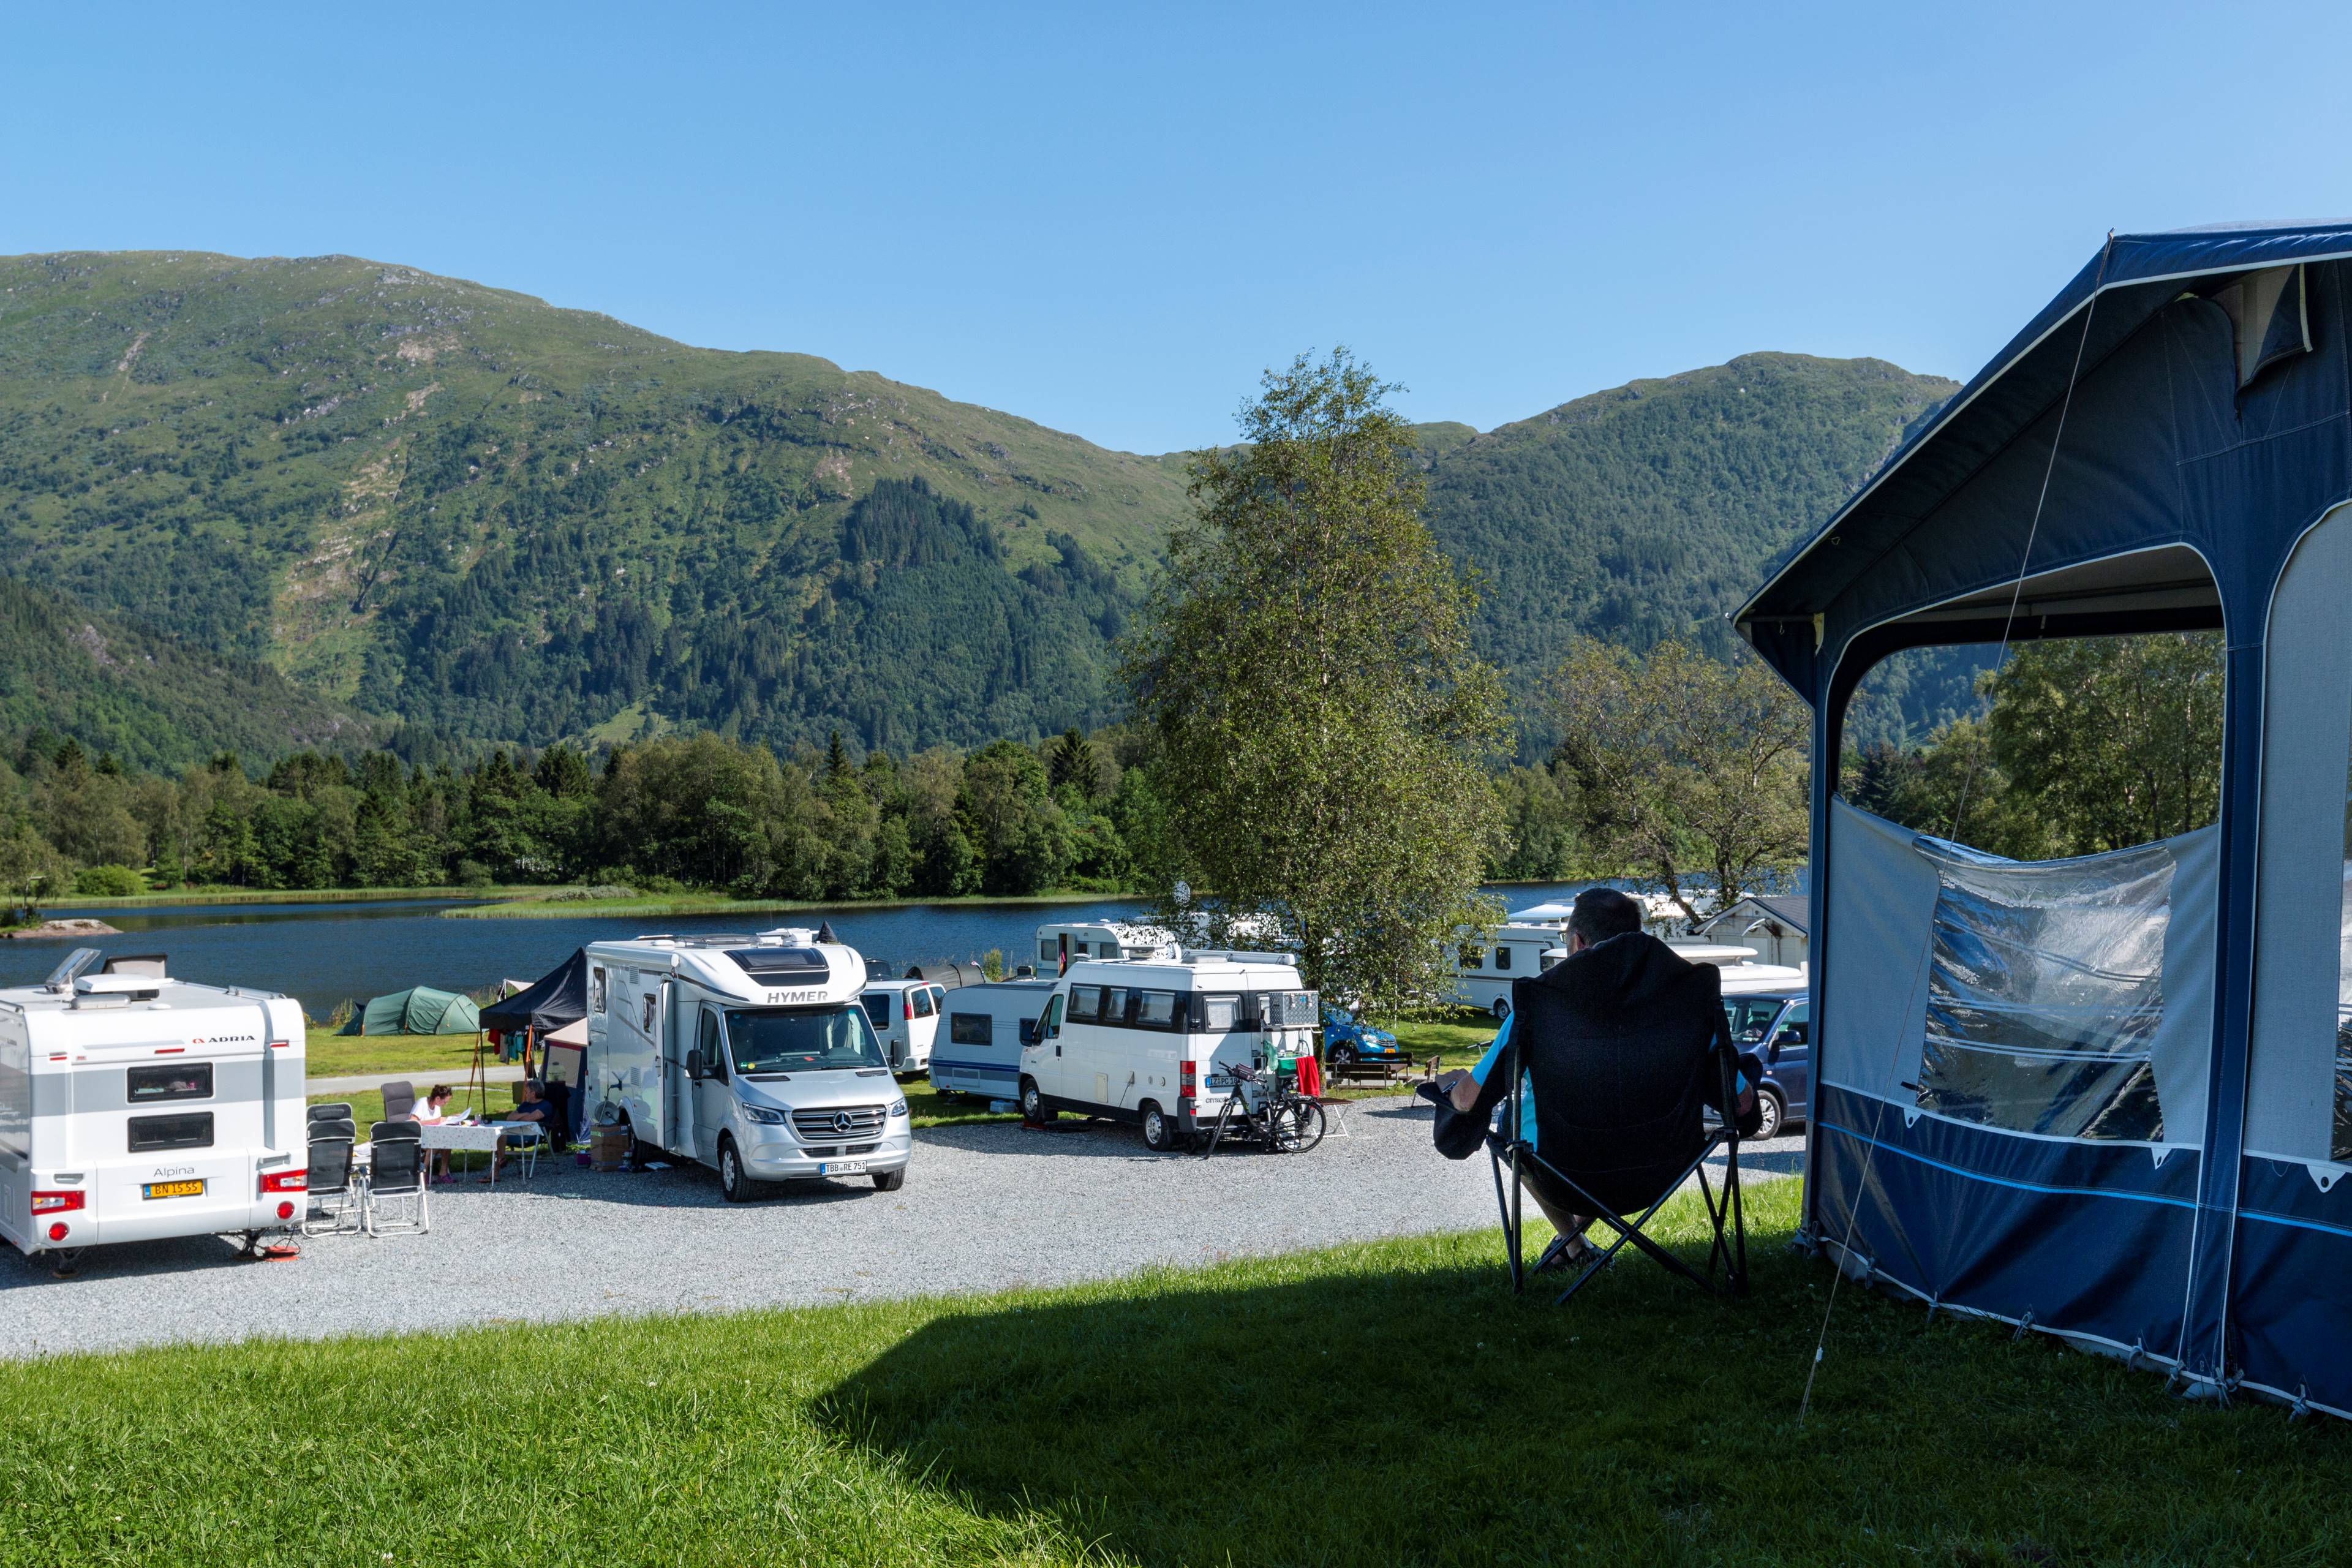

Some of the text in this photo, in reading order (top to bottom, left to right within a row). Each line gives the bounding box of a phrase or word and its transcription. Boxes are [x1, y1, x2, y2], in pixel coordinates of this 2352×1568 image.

[767, 991, 828, 1003] HYMER
[853, 1162, 865, 1170] 751
[153, 1167, 195, 1178] Alpina
[155, 1182, 197, 1194] BN 15 55
